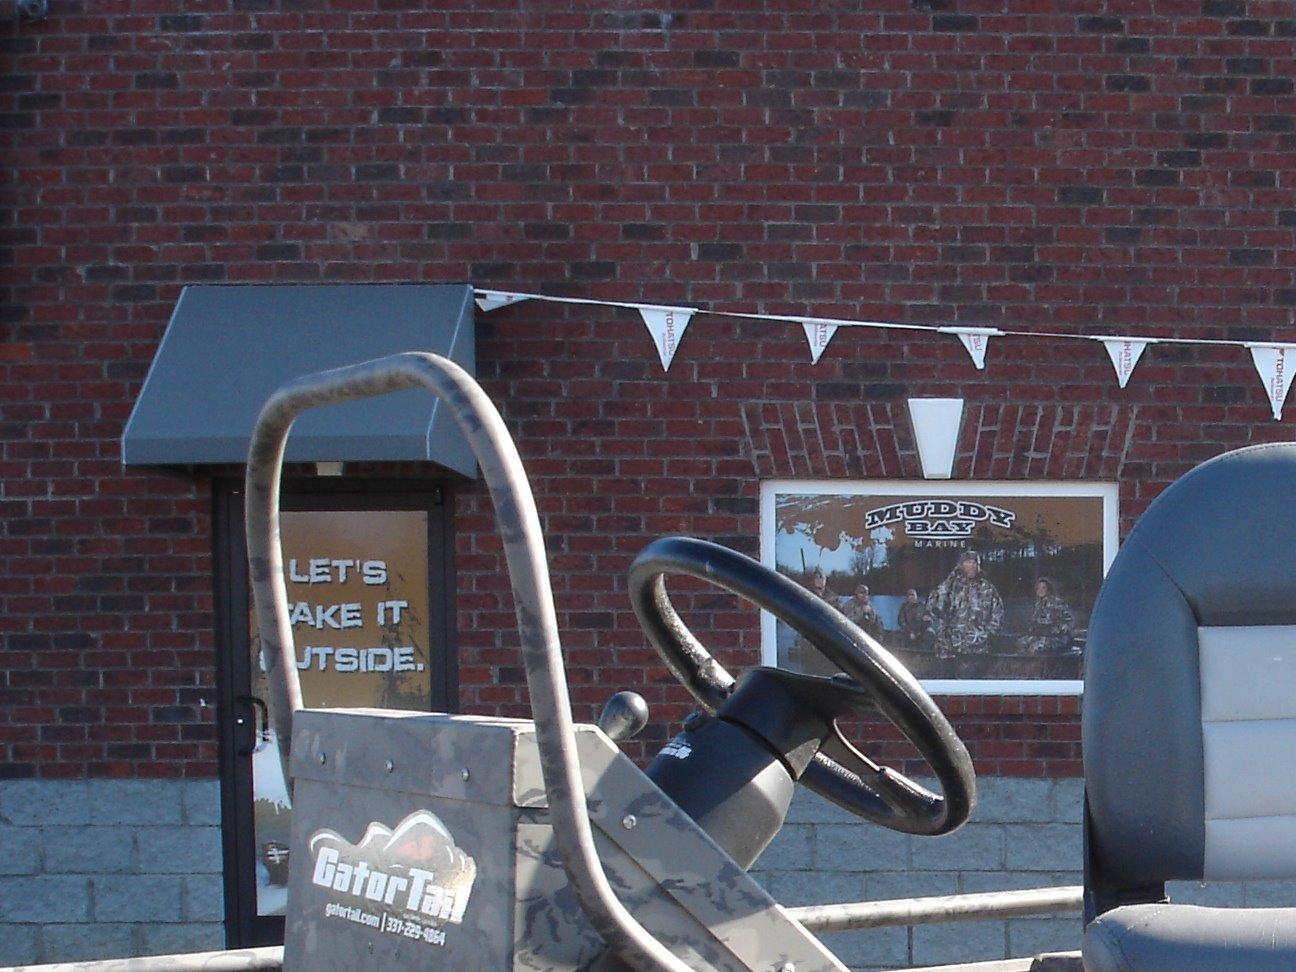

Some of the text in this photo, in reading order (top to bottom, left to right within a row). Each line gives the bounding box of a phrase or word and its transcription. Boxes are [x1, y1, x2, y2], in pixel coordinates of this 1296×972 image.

[665, 311, 676, 356] TOHATSU
[1275, 358, 1284, 402] TOHATSU
[865, 500, 1015, 529] MUDDY
[906, 520, 975, 535] BAY
[914, 540, 967, 549] MARINE
[289, 557, 388, 586] LET'S
[288, 600, 408, 630] AKE IT
[312, 846, 475, 924] GatorTail
[325, 902, 380, 928] gatortail.com
